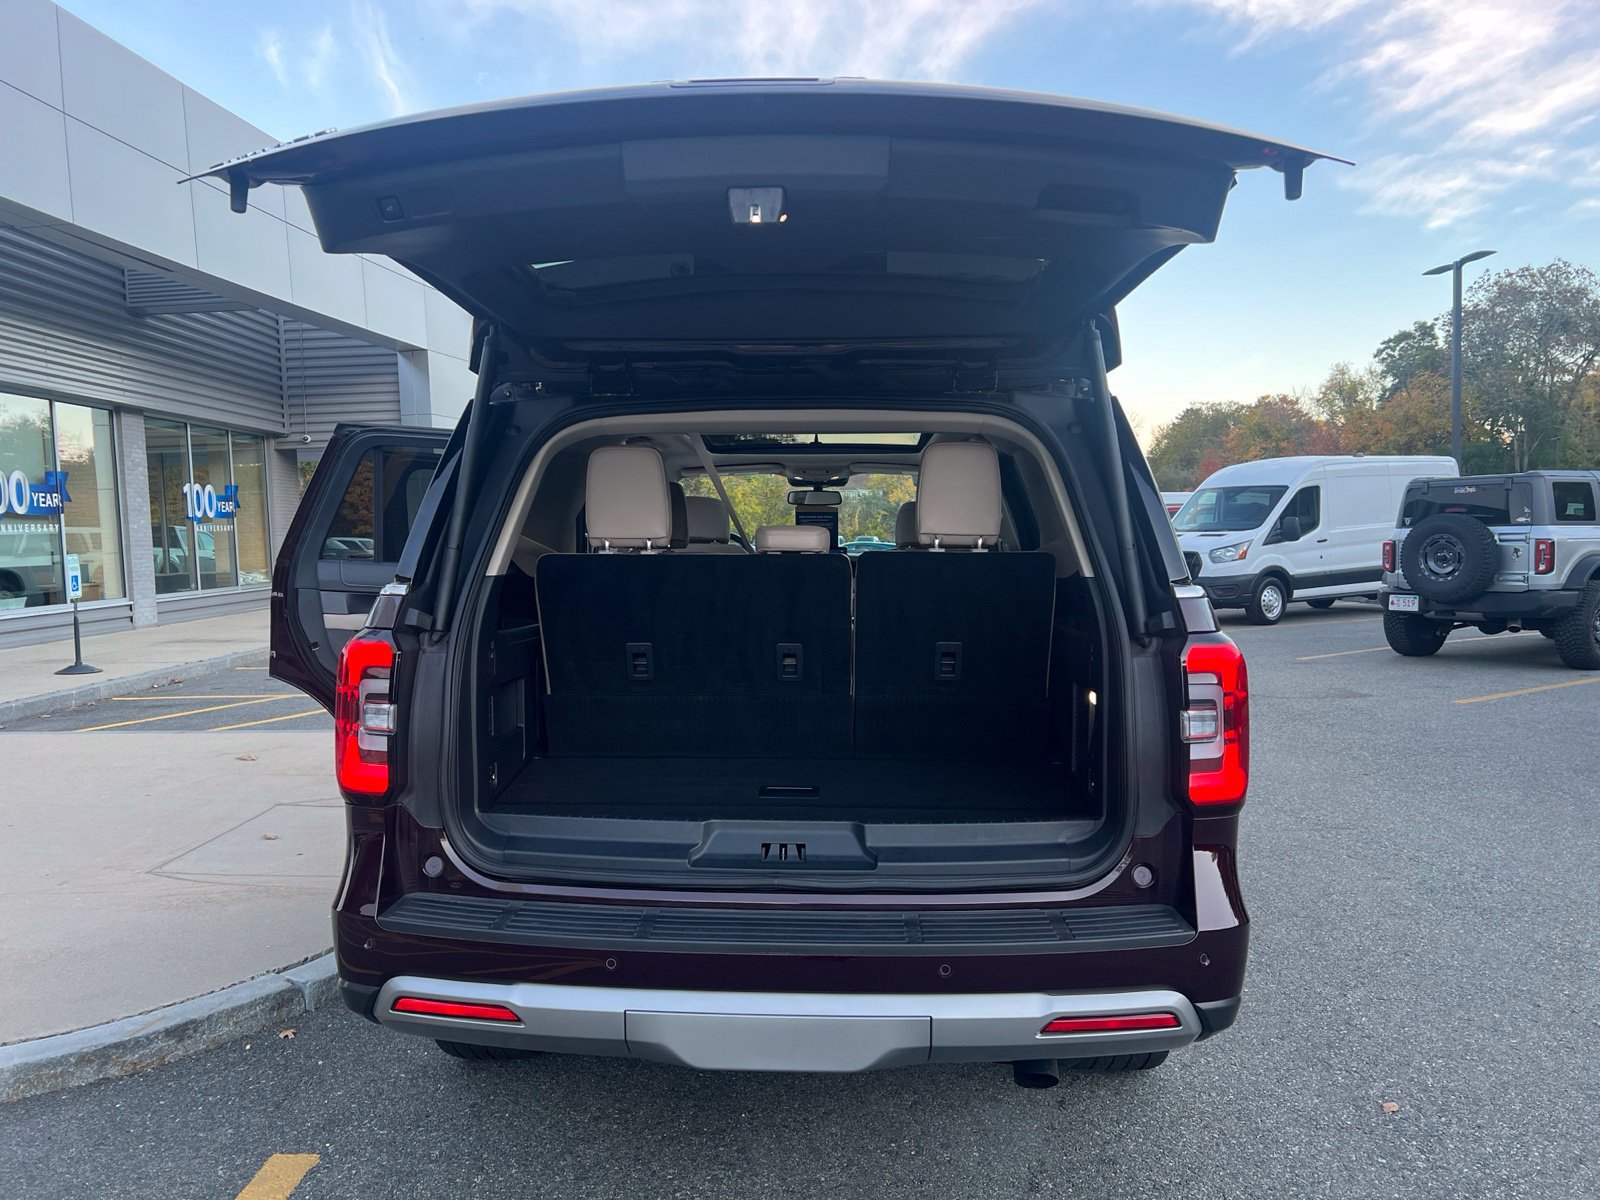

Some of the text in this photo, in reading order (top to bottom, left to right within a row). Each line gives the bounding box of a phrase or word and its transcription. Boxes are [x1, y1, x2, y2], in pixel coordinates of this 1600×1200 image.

[31, 492, 62, 507] YEAR
[183, 483, 216, 518] 100
[0, 524, 59, 532] NNIVERSARY
